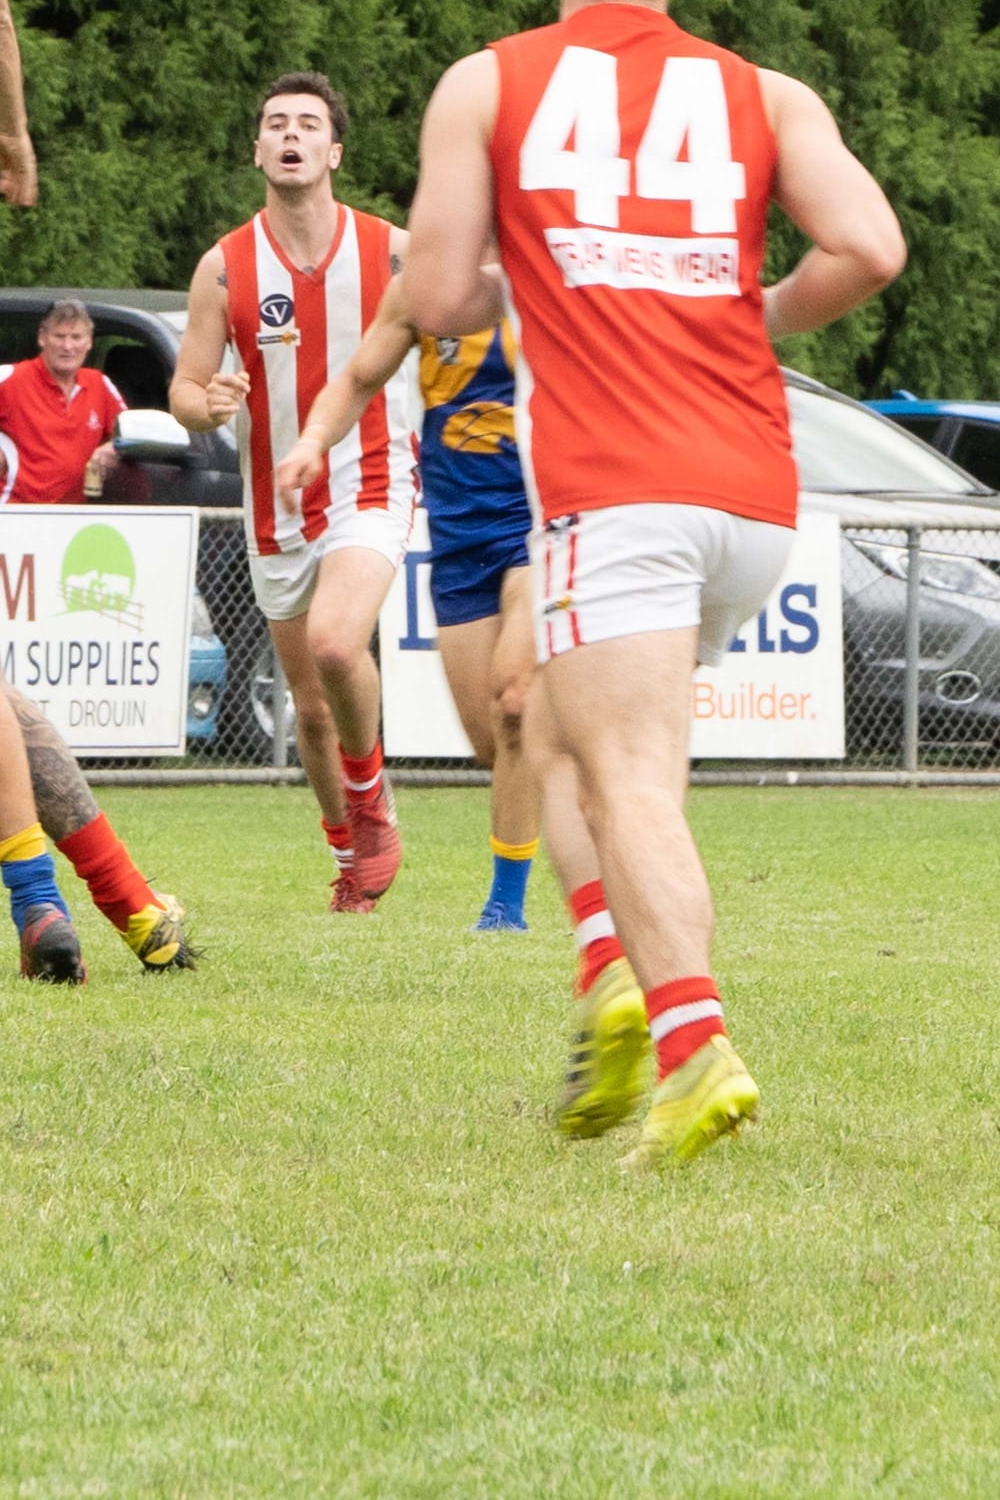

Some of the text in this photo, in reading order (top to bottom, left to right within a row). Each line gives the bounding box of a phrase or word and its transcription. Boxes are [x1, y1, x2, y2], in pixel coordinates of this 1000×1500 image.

[519, 45, 746, 233] 44
[26, 641, 160, 686] SUPPLIES
[69, 699, 146, 727] DROUIN
[693, 682, 817, 721] Builder.
